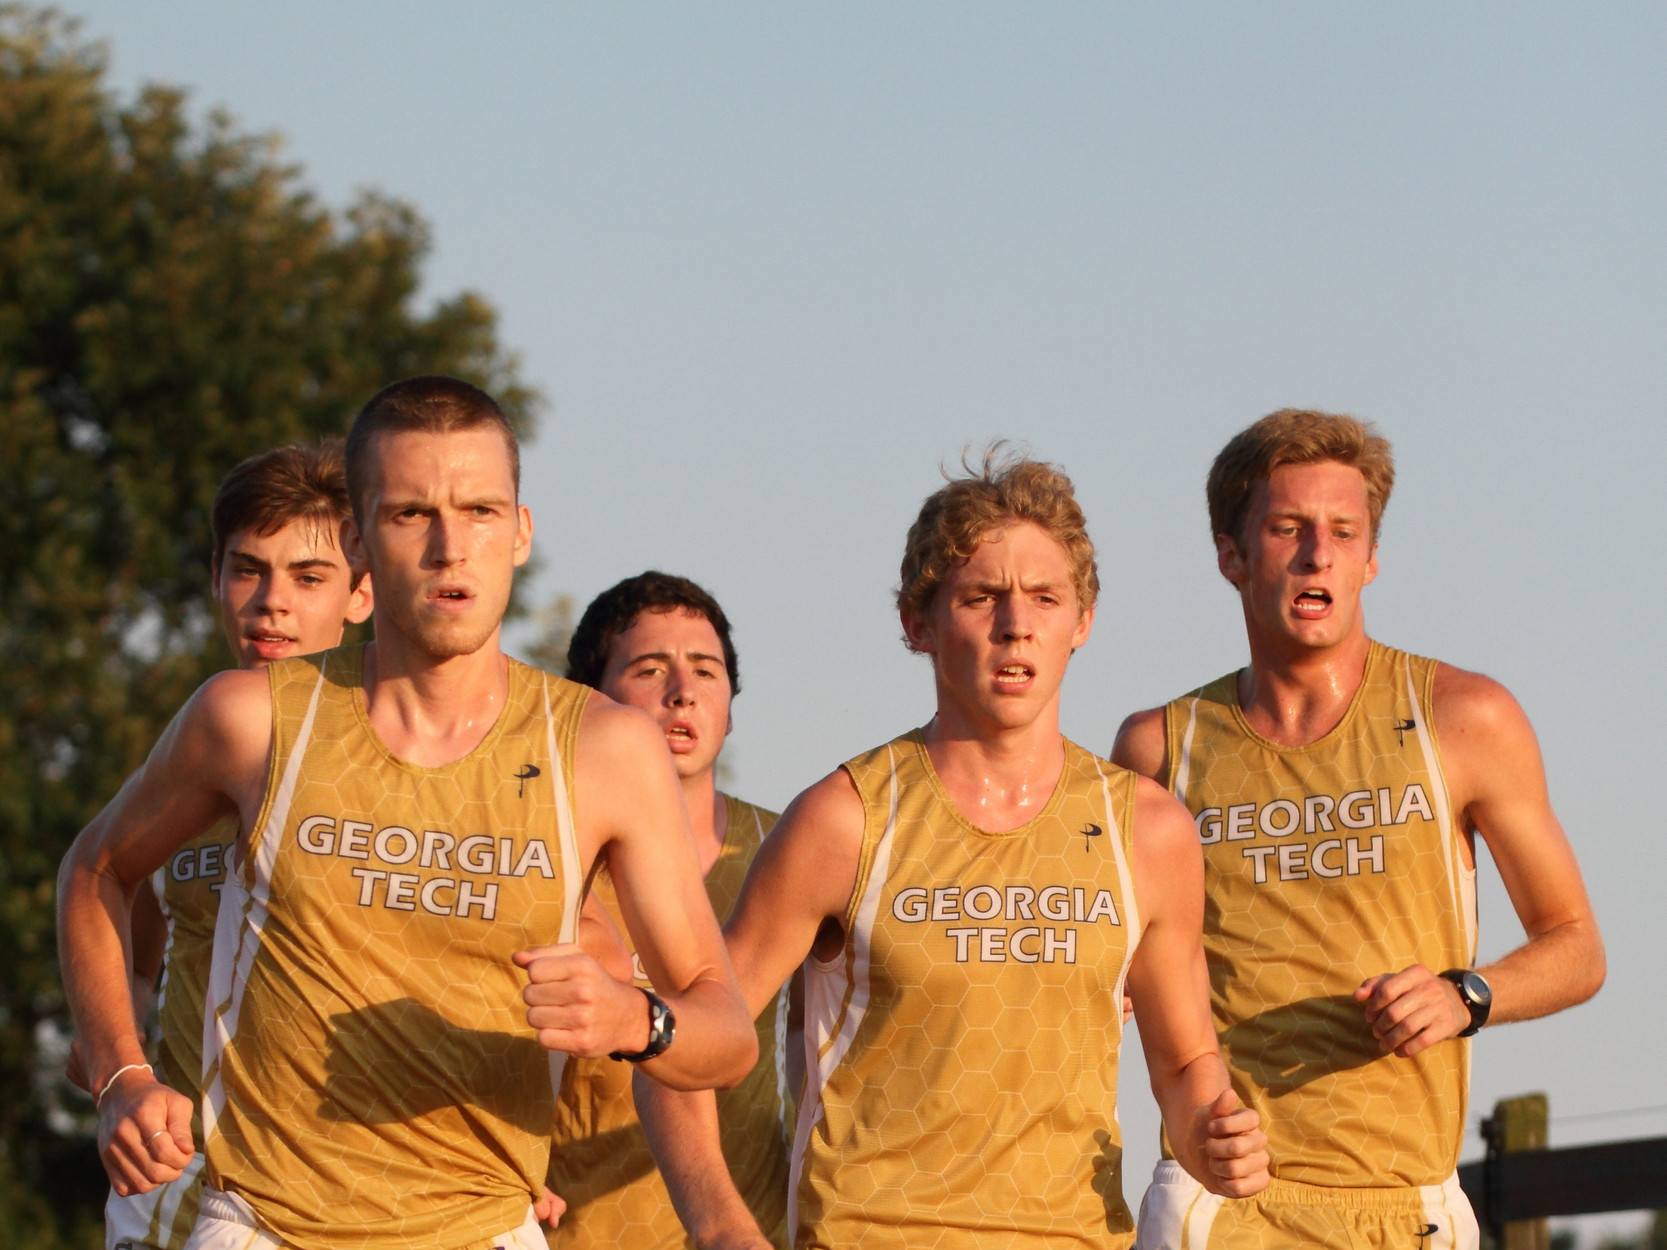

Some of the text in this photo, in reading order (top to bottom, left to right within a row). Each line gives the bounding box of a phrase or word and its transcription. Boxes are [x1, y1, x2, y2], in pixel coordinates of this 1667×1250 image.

[1195, 783, 1435, 845] GEORGIA
[297, 815, 555, 879] GEORGIA
[1242, 836, 1386, 884] TECH
[351, 868, 498, 920] TECH
[892, 885, 1121, 926] GEORGIA
[946, 928, 1077, 964] TECH
